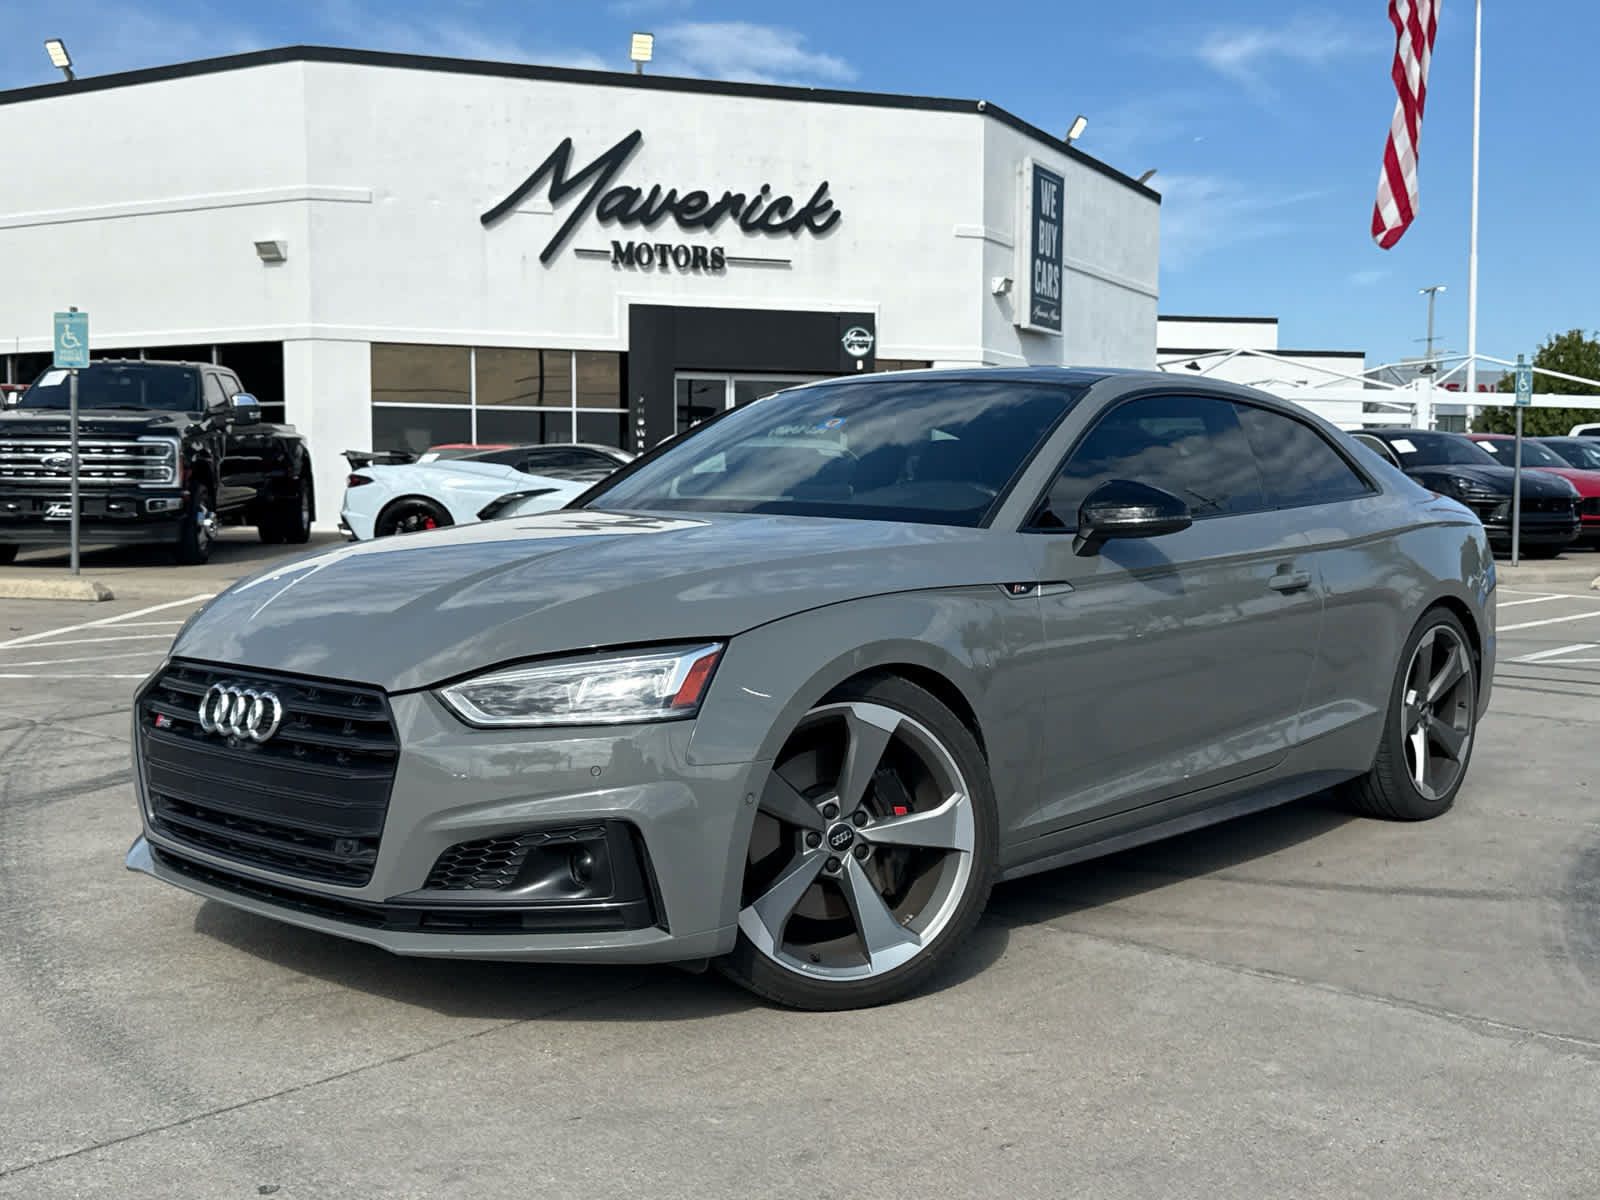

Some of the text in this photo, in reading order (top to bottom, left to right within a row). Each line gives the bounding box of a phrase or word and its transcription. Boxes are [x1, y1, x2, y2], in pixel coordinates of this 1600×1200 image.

[480, 129, 841, 264] Maverick
[1040, 179, 1057, 219] WE
[611, 241, 725, 269] MOTORS
[1038, 219, 1058, 259] BUY
[1034, 258, 1060, 300] CARS
